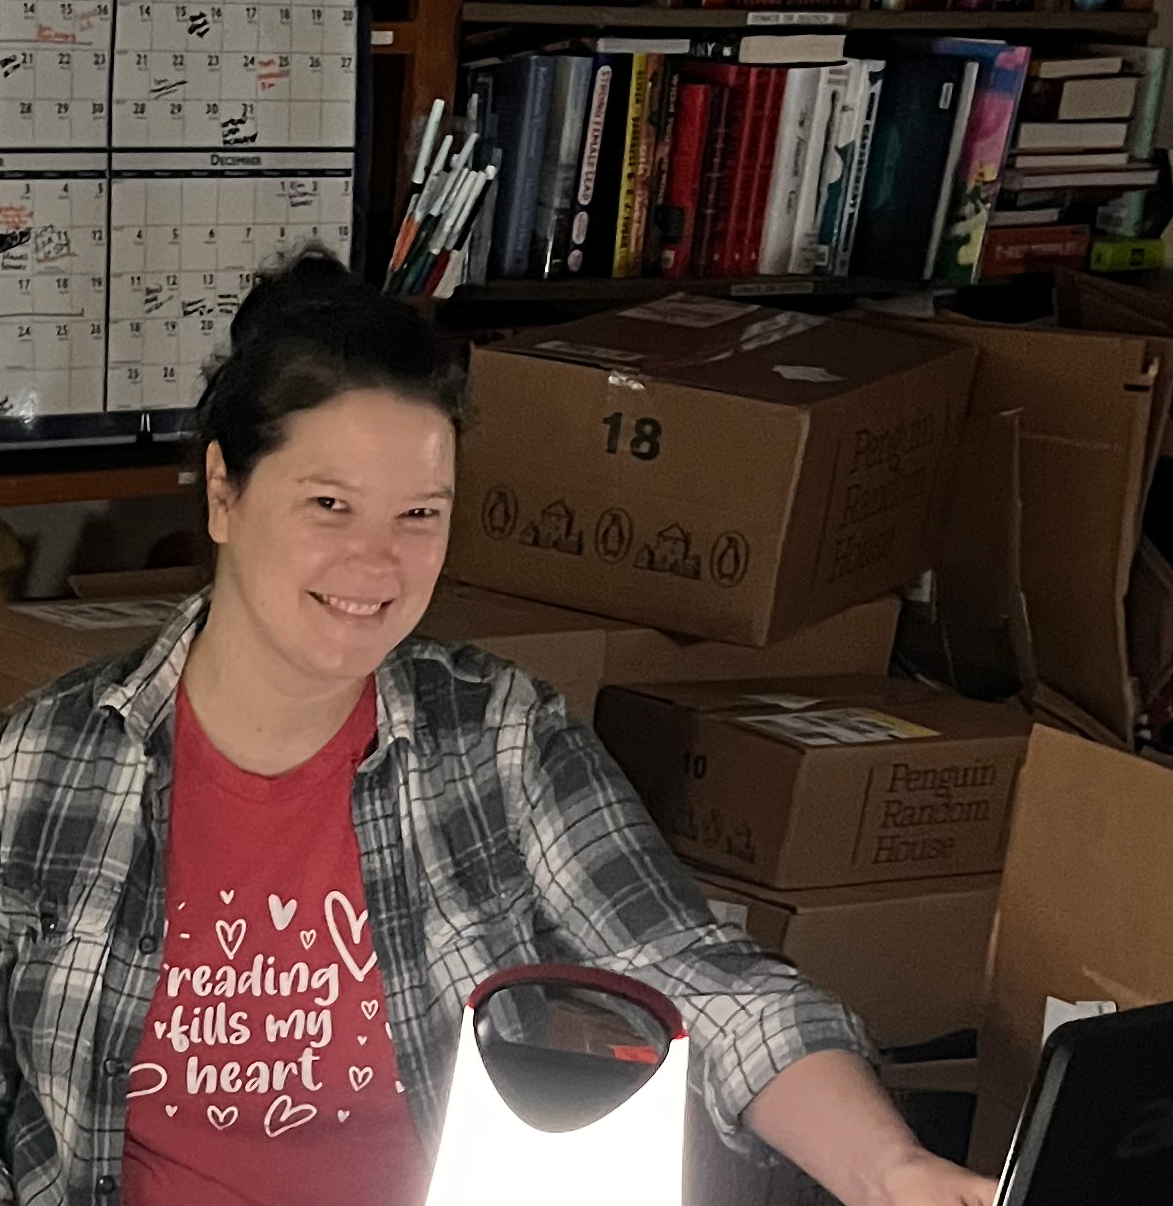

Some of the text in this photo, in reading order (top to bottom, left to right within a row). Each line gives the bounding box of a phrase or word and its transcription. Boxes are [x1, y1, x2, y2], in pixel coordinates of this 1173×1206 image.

[57, 54, 71, 64] 22
[135, 54, 255, 67] 21 22 24
[132, 103, 146, 114] 28
[17, 279, 31, 290] 17
[130, 275, 178, 286] 11 12
[55, 324, 69, 336] 25
[602, 412, 663, 461] 18
[886, 758, 997, 799] Penguin
[879, 799, 990, 829] Random
[872, 834, 955, 864] House
[167, 954, 339, 1006] reading
[166, 1002, 332, 1052] fills my
[186, 1047, 323, 1094] heart
